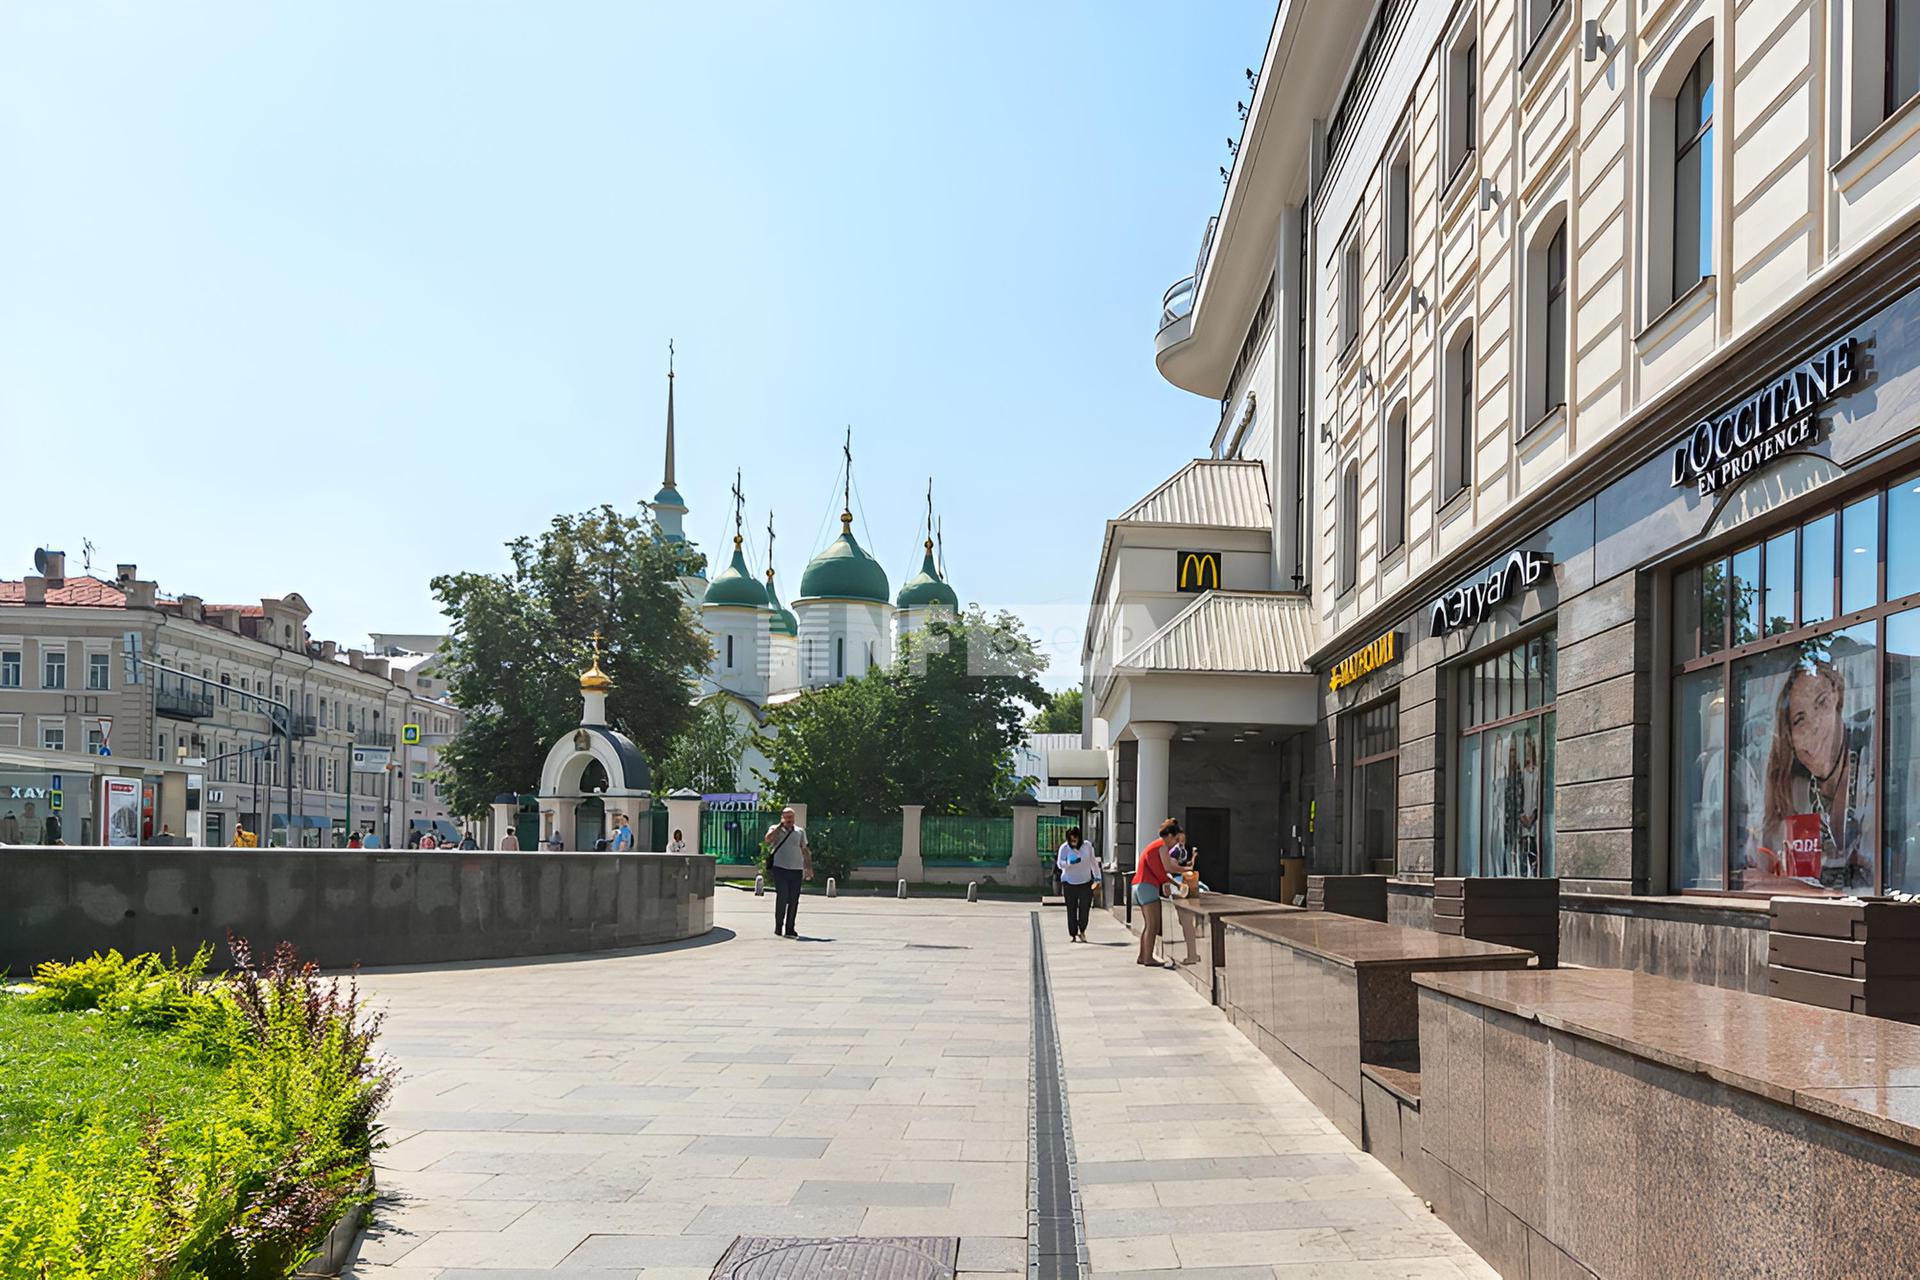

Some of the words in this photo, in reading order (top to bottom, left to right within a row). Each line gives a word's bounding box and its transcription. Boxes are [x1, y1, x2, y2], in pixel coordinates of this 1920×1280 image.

[1670, 337, 1855, 487] L'OCCITANE
[1698, 469, 1717, 496] EN
[1722, 416, 1811, 484] PROVENCE
